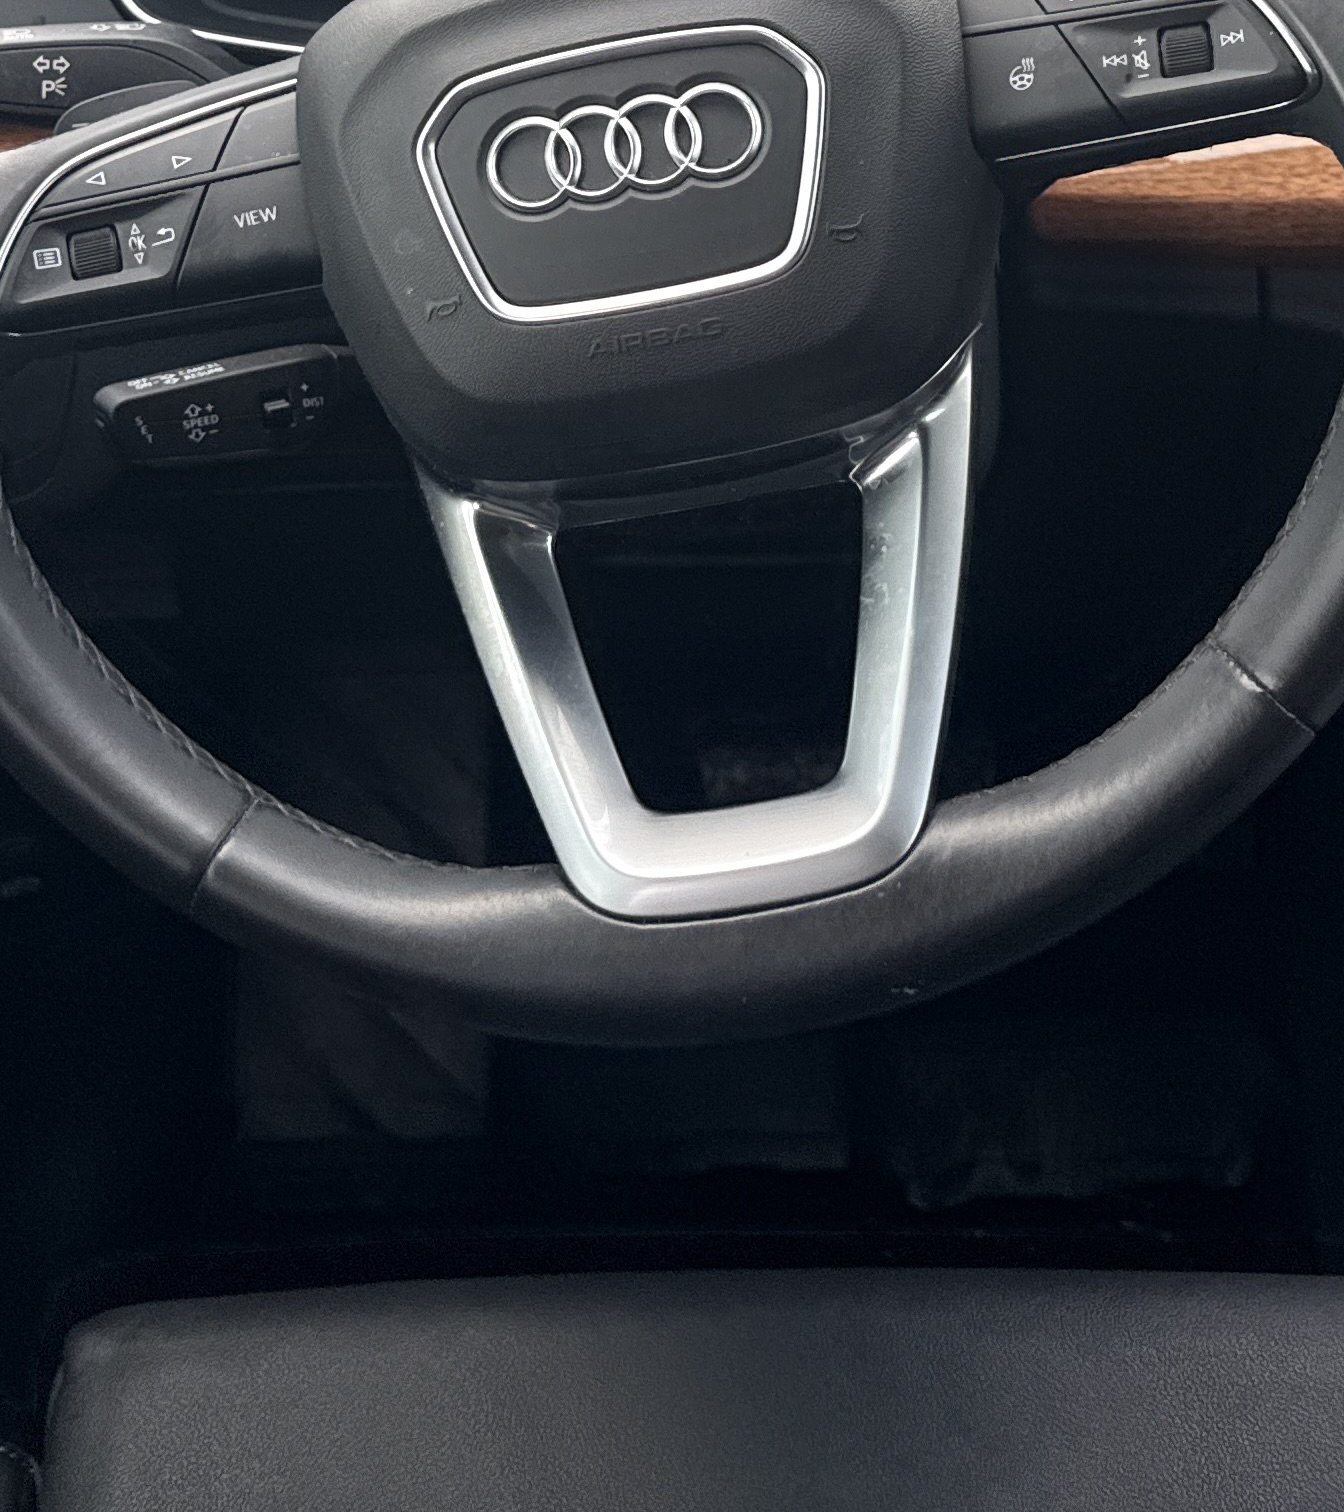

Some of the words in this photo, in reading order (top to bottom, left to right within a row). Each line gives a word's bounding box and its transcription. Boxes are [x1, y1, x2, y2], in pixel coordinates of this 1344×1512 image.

[233, 205, 278, 229] VIEW
[128, 234, 147, 251] OK
[587, 316, 722, 358] AIRBAG
[182, 413, 219, 429] SPEED
